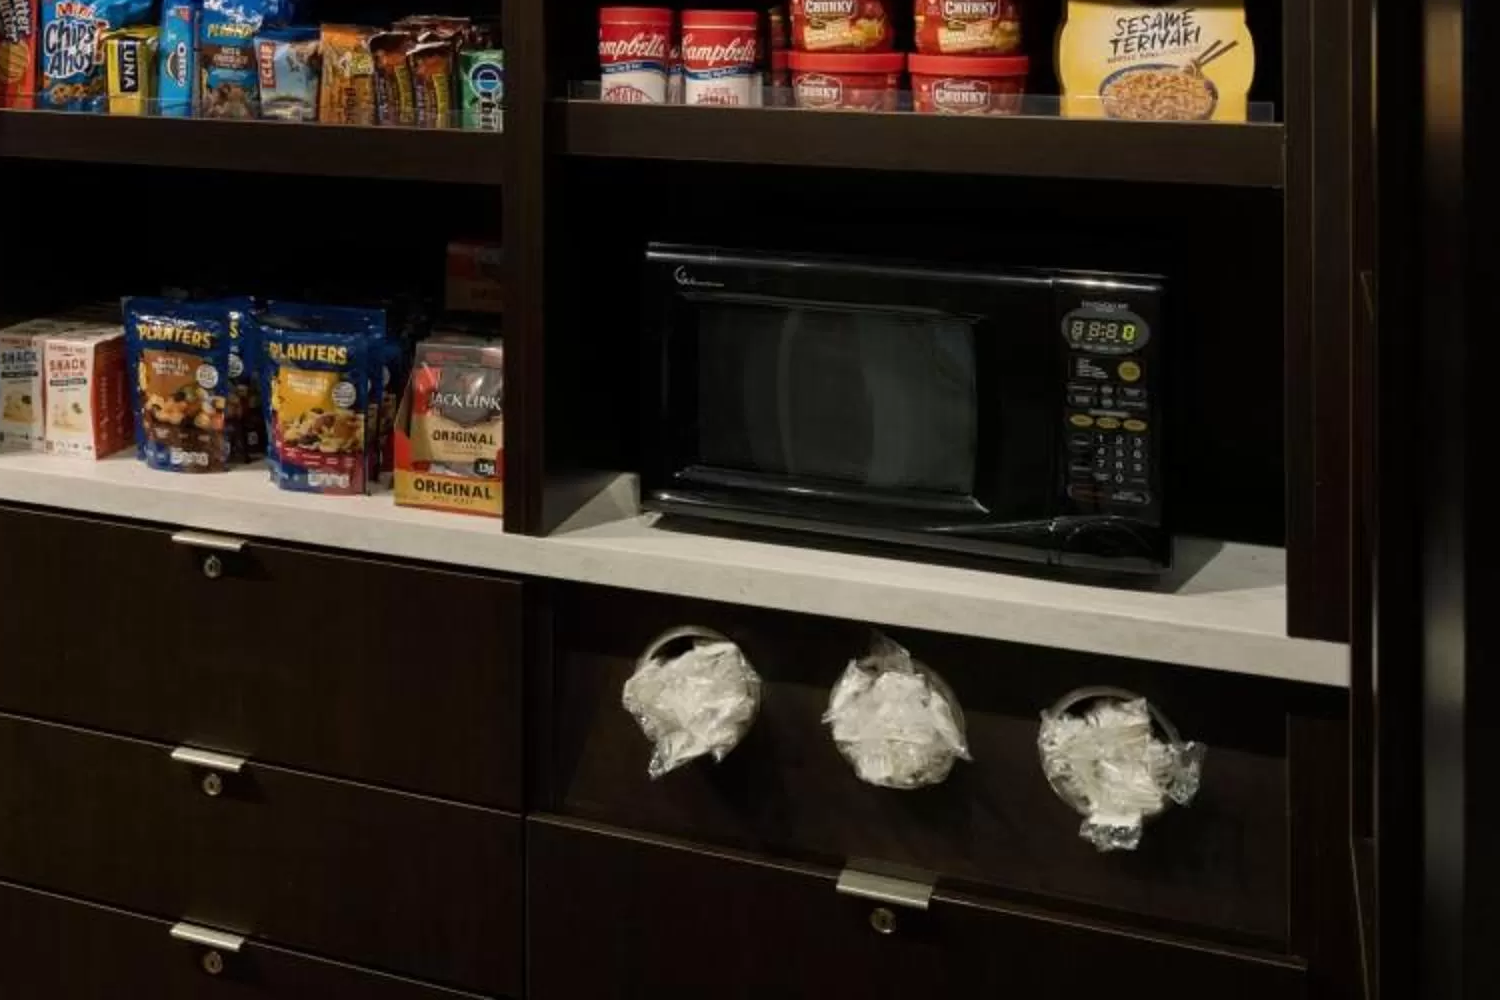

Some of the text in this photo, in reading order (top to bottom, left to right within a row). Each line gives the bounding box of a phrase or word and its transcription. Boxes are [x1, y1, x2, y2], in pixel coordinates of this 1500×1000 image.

[1114, 7, 1196, 36] SESAME
[1109, 26, 1201, 55] TERIYAKI
[124, 38, 137, 90] LUNA
[268, 341, 349, 365] PLANTERS
[432, 429, 496, 447] ORIGINAL
[414, 477, 494, 500] ORIGINAL
